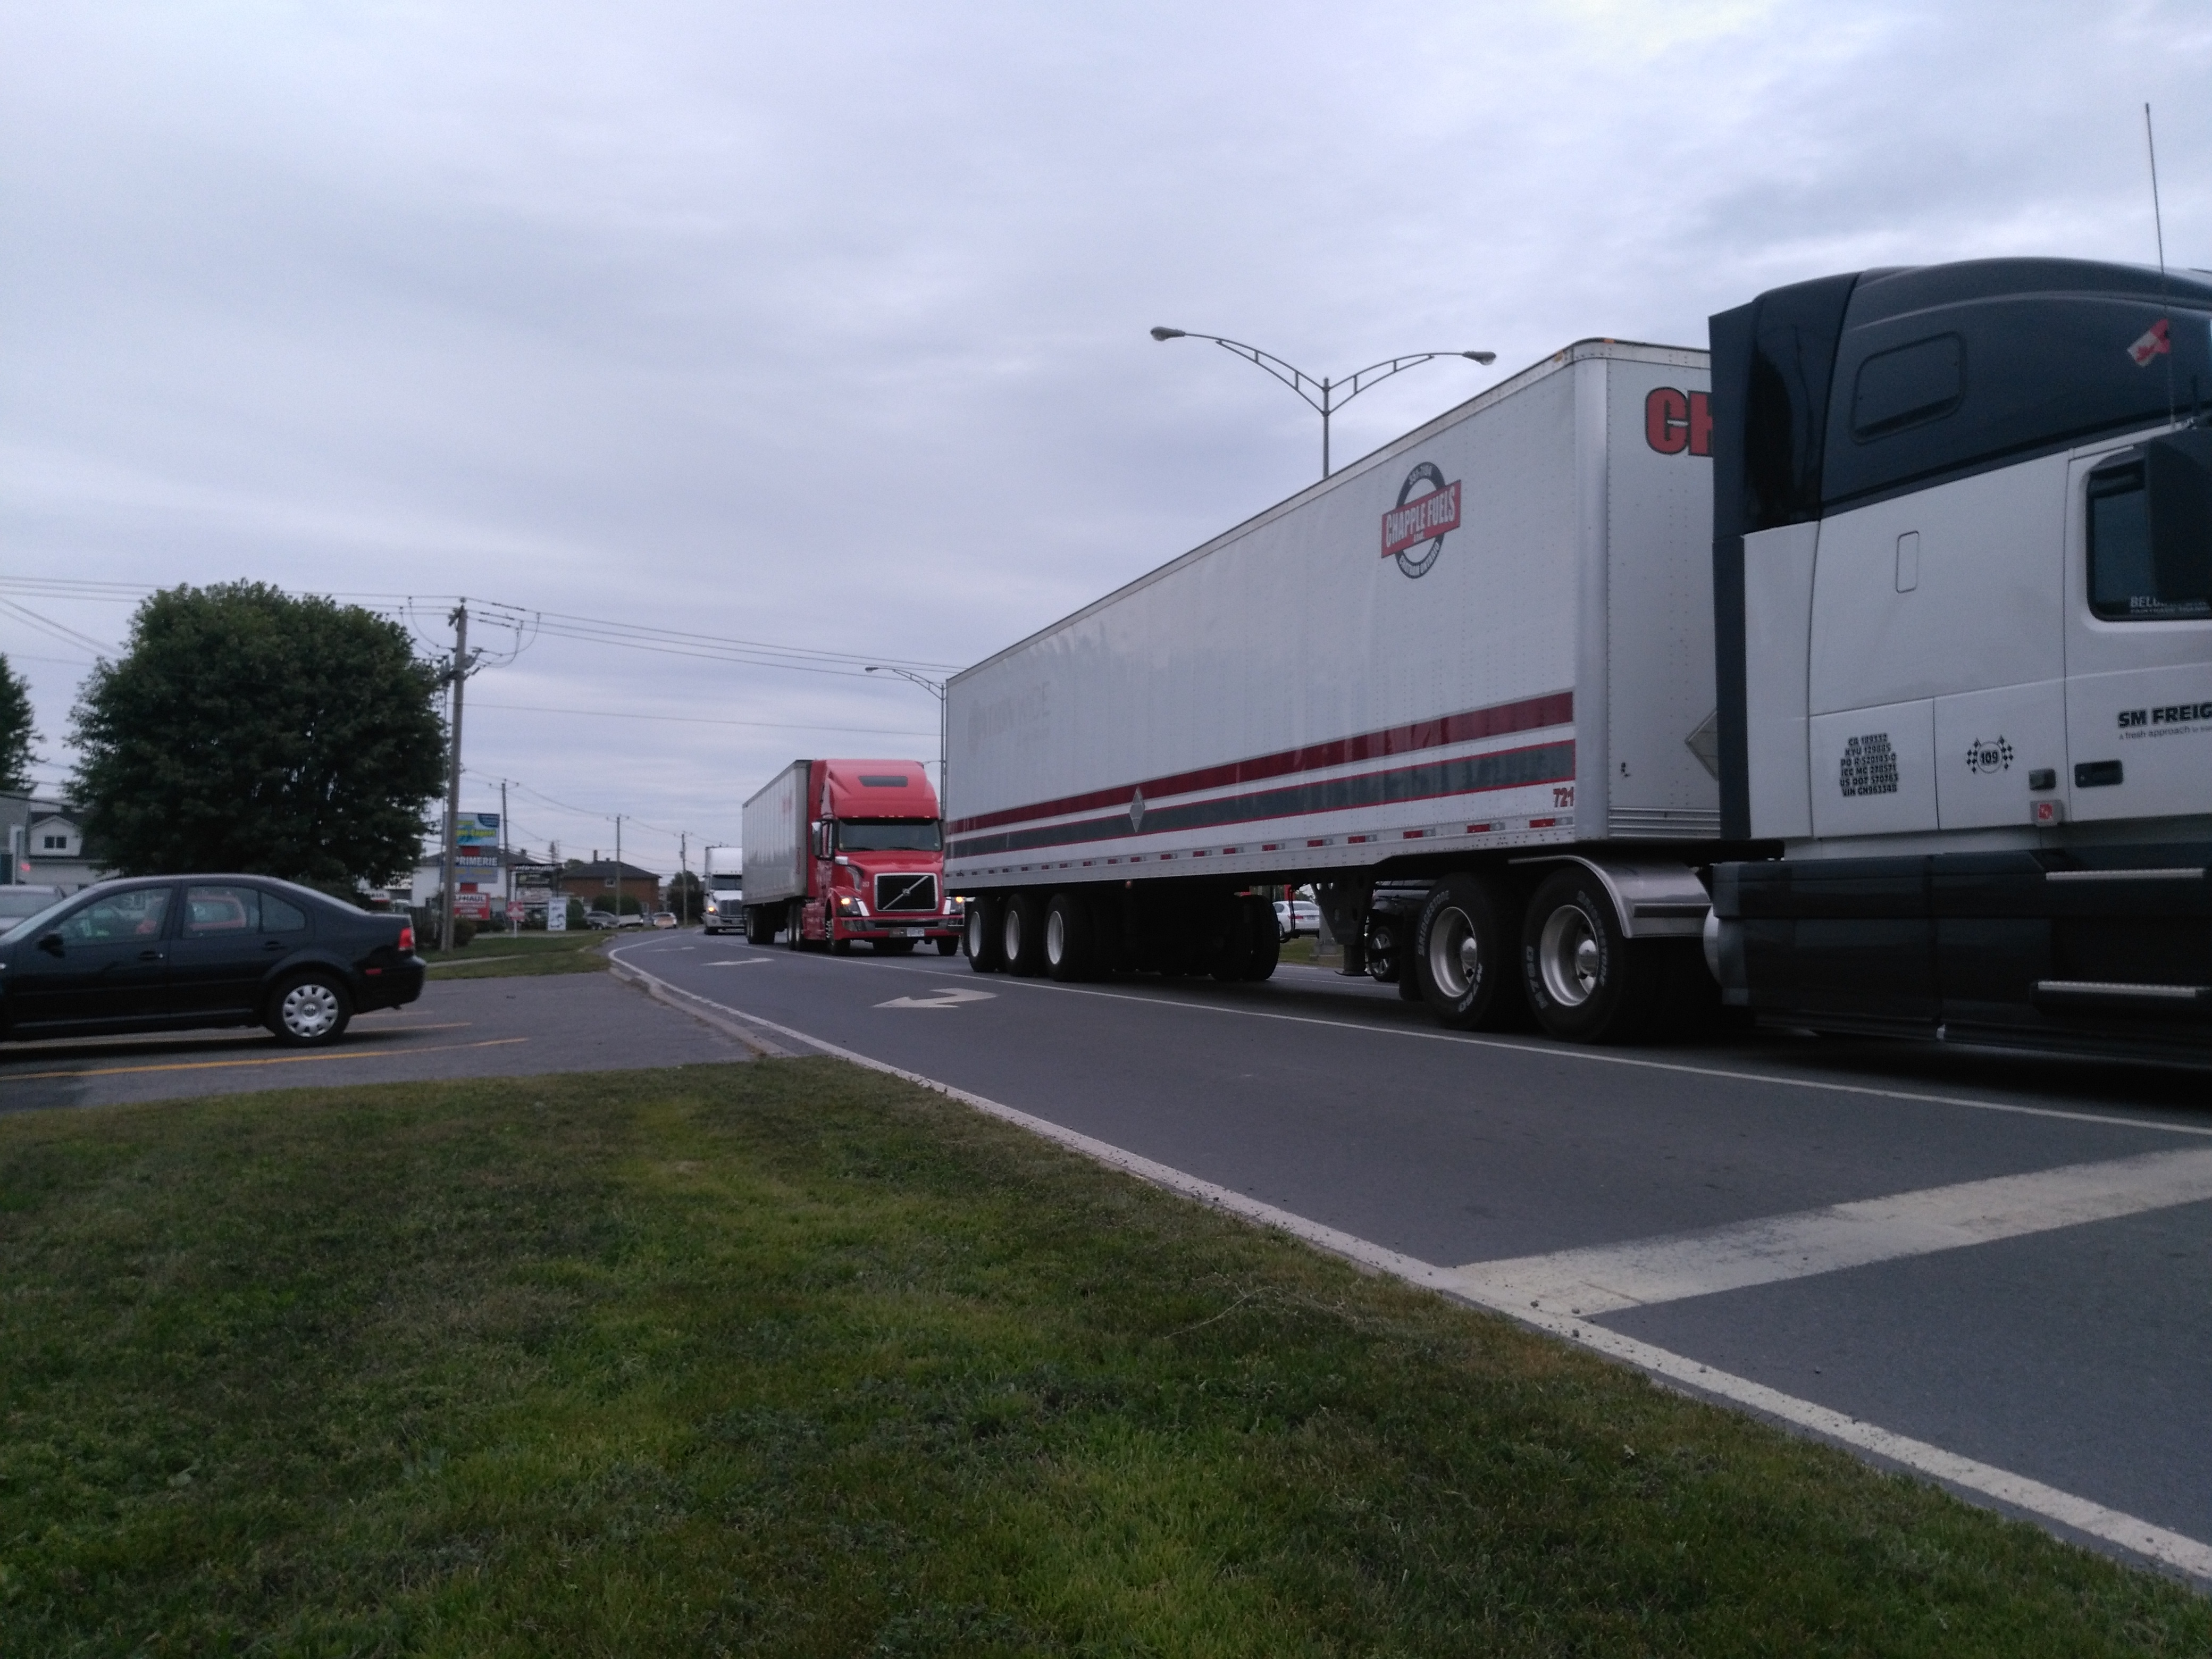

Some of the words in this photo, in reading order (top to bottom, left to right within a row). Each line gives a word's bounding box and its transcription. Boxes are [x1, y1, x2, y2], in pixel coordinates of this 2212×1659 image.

[1386, 502, 1425, 547] CHAPPLE
[1427, 485, 1455, 527] FUELS
[2118, 709, 2147, 728] SM
[2125, 731, 2146, 739] fresh
[2148, 726, 2190, 738] approach
[1981, 750, 1999, 765] 109
[1840, 778, 1850, 787] US
[1853, 777, 1869, 785] DOT
[1553, 787, 1574, 808] 721
[456, 857, 498, 867] PRIMERIE
[1418, 890, 1449, 956] BRIDGESTONE
